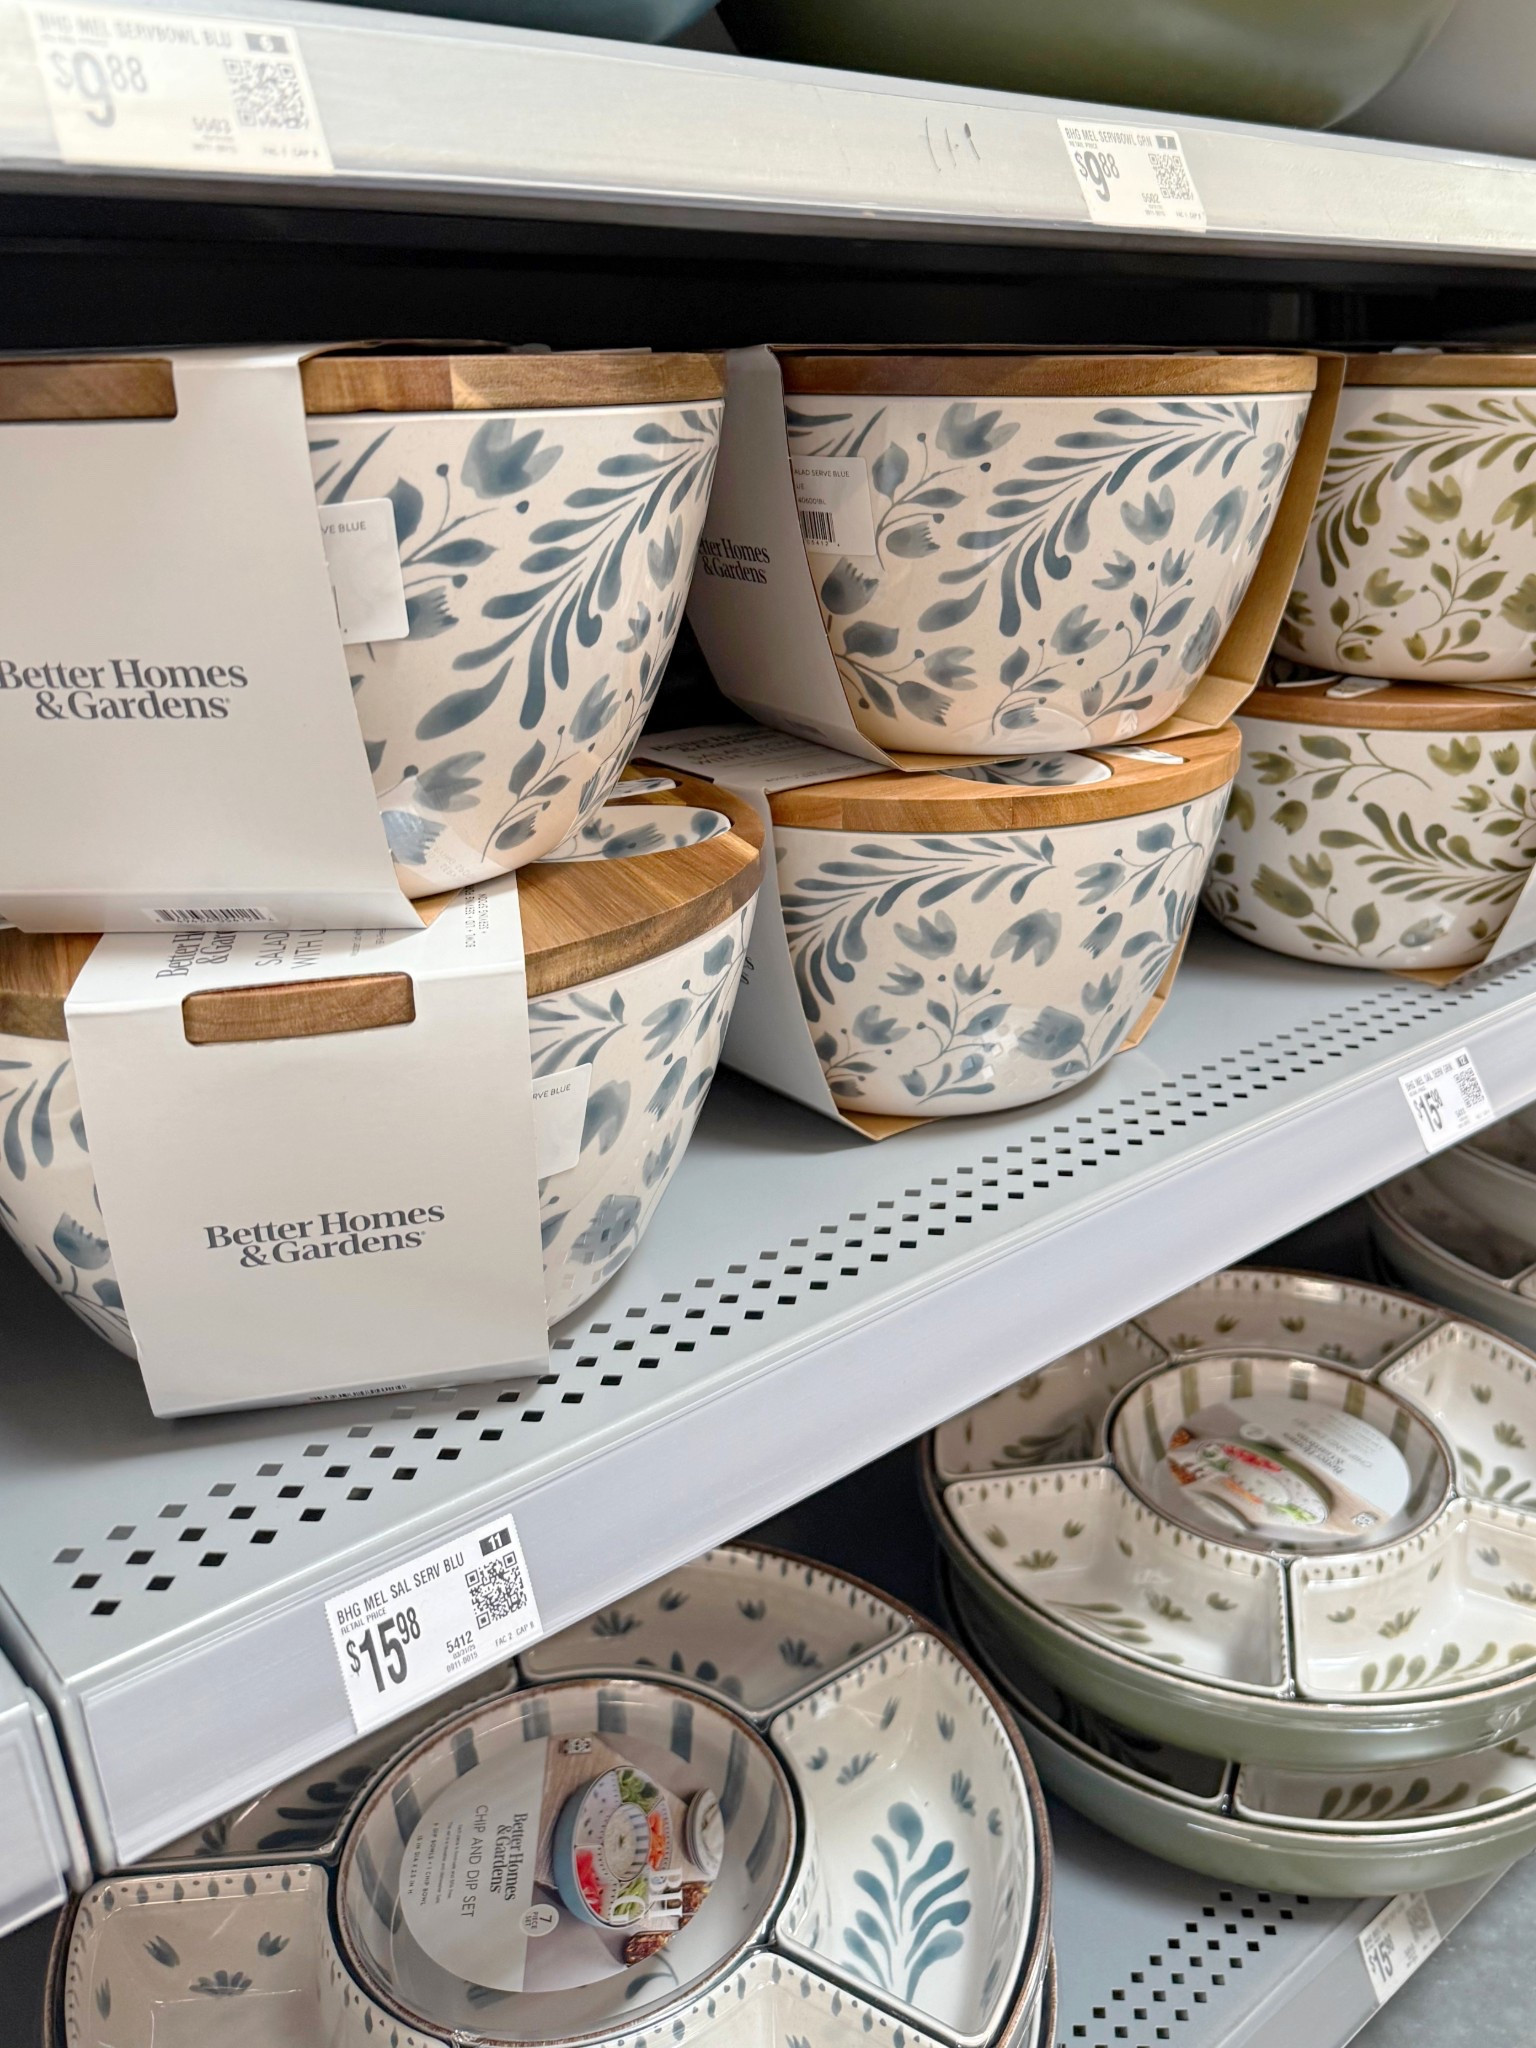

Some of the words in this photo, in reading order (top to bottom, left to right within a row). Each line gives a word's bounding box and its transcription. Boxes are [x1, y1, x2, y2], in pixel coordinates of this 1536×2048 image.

[1082, 129, 1098, 142] MEL
[338, 521, 366, 534] BLUE
[721, 538, 770, 563] Homes
[0, 659, 104, 690] Better
[108, 659, 248, 688] Homes
[156, 943, 201, 979] Better
[255, 932, 290, 966] SALAD
[551, 1084, 571, 1095] BLUE
[204, 1220, 313, 1249] Better
[318, 1204, 445, 1236] Homes
[337, 1602, 361, 1625] BHG
[364, 1592, 388, 1616] MEL
[390, 1579, 412, 1599] SAL
[413, 1563, 440, 1588] SERV
[444, 1552, 465, 1573] BLU
[487, 1535, 503, 1550] 11
[341, 1621, 364, 1635] RETAIL
[367, 1608, 387, 1623] PRICE
[446, 1631, 473, 1654] 5412
[474, 1804, 489, 1833] CHIP
[510, 1813, 528, 1851] Better
[468, 1838, 483, 1865] AND
[465, 1870, 480, 1890] DIP
[504, 1853, 524, 1901] Homes
[461, 1896, 476, 1917] SET
[531, 1911, 539, 1929] PIECE
[539, 1915, 553, 1923] 7
